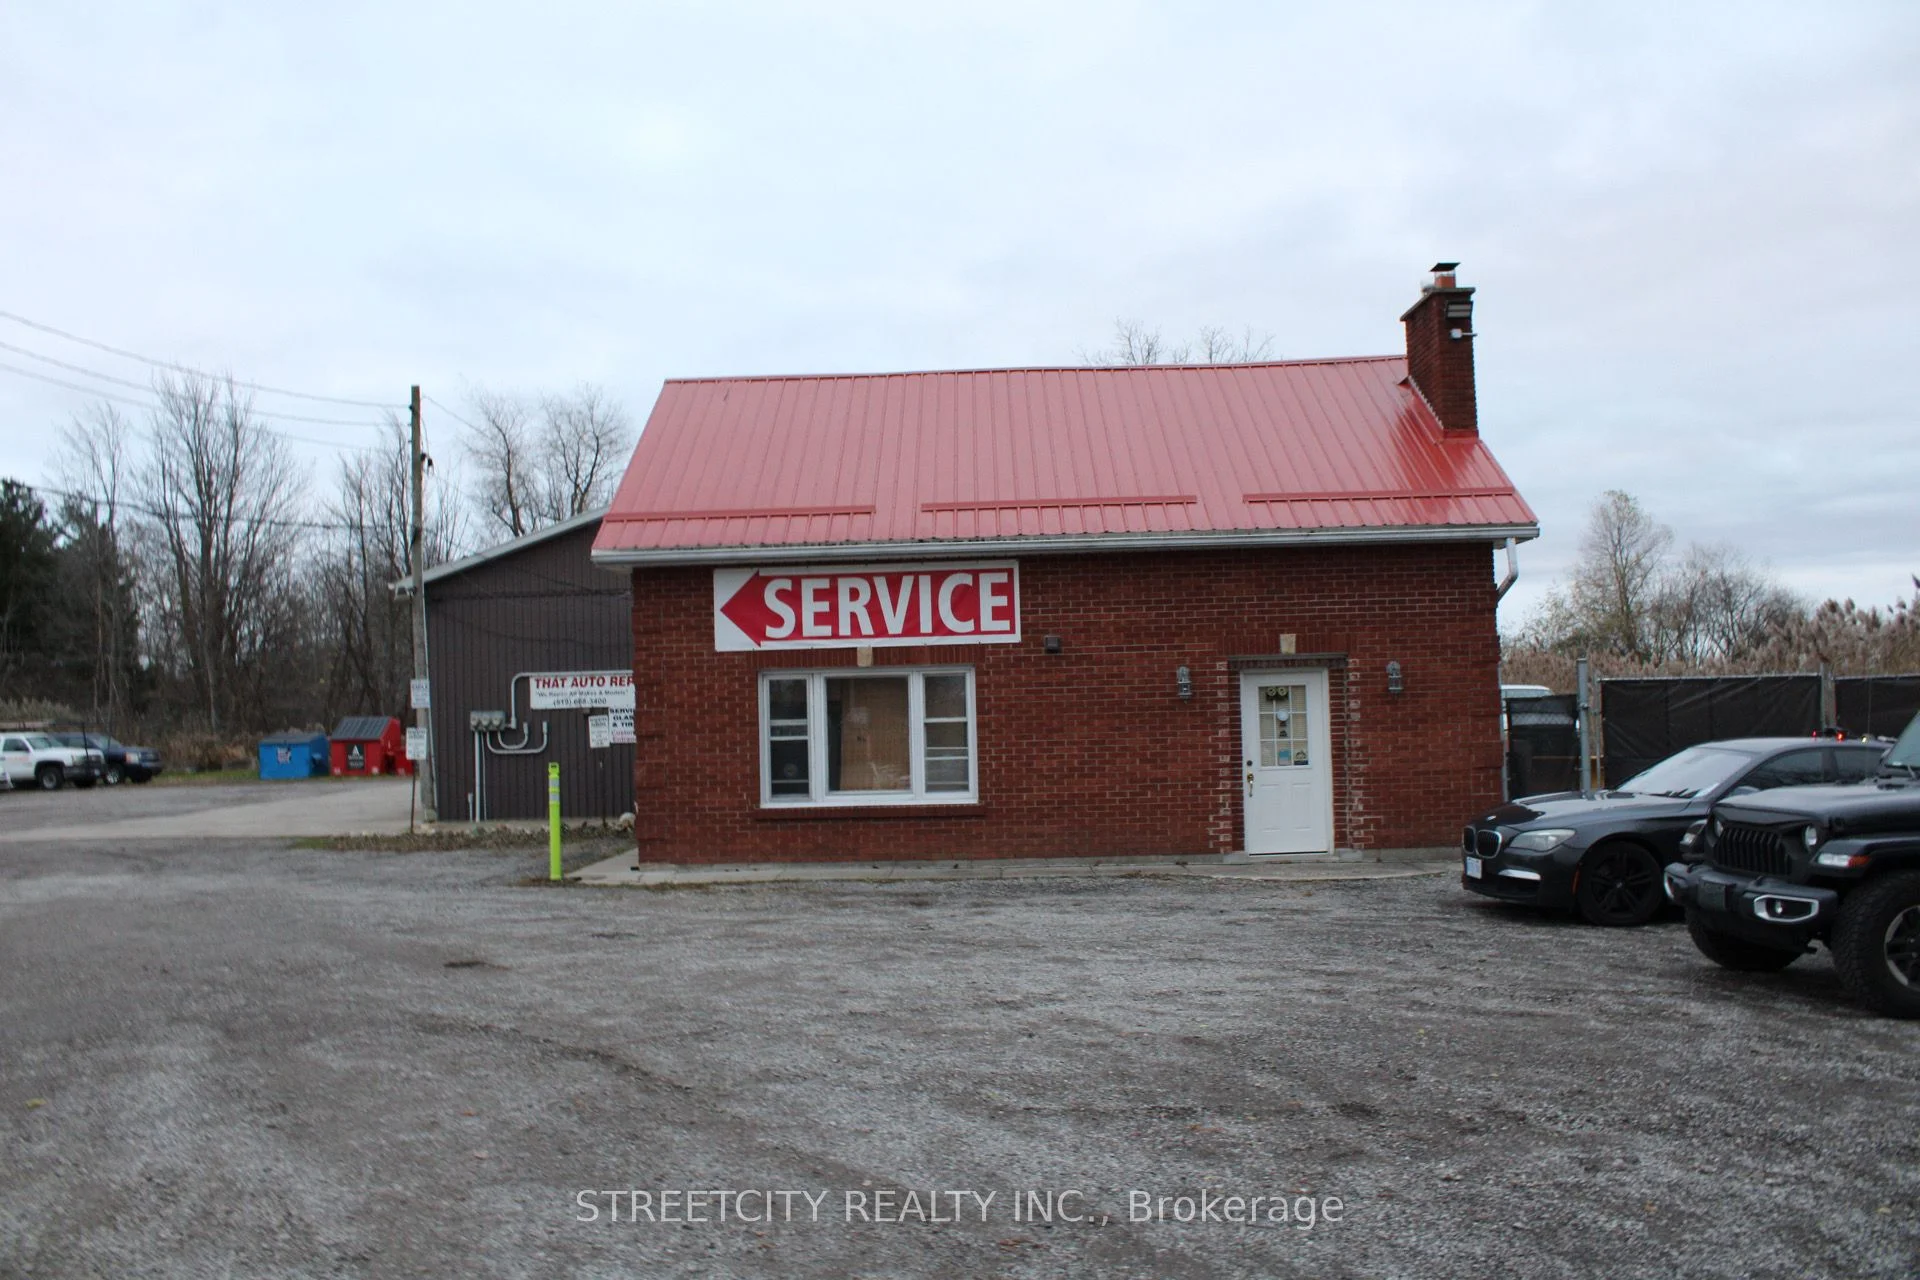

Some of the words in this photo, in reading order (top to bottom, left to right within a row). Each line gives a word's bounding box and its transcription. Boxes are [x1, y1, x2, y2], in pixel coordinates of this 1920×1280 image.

[763, 572, 1011, 639] SERVICE
[535, 677, 567, 688] THAT
[571, 676, 606, 687] AUTO
